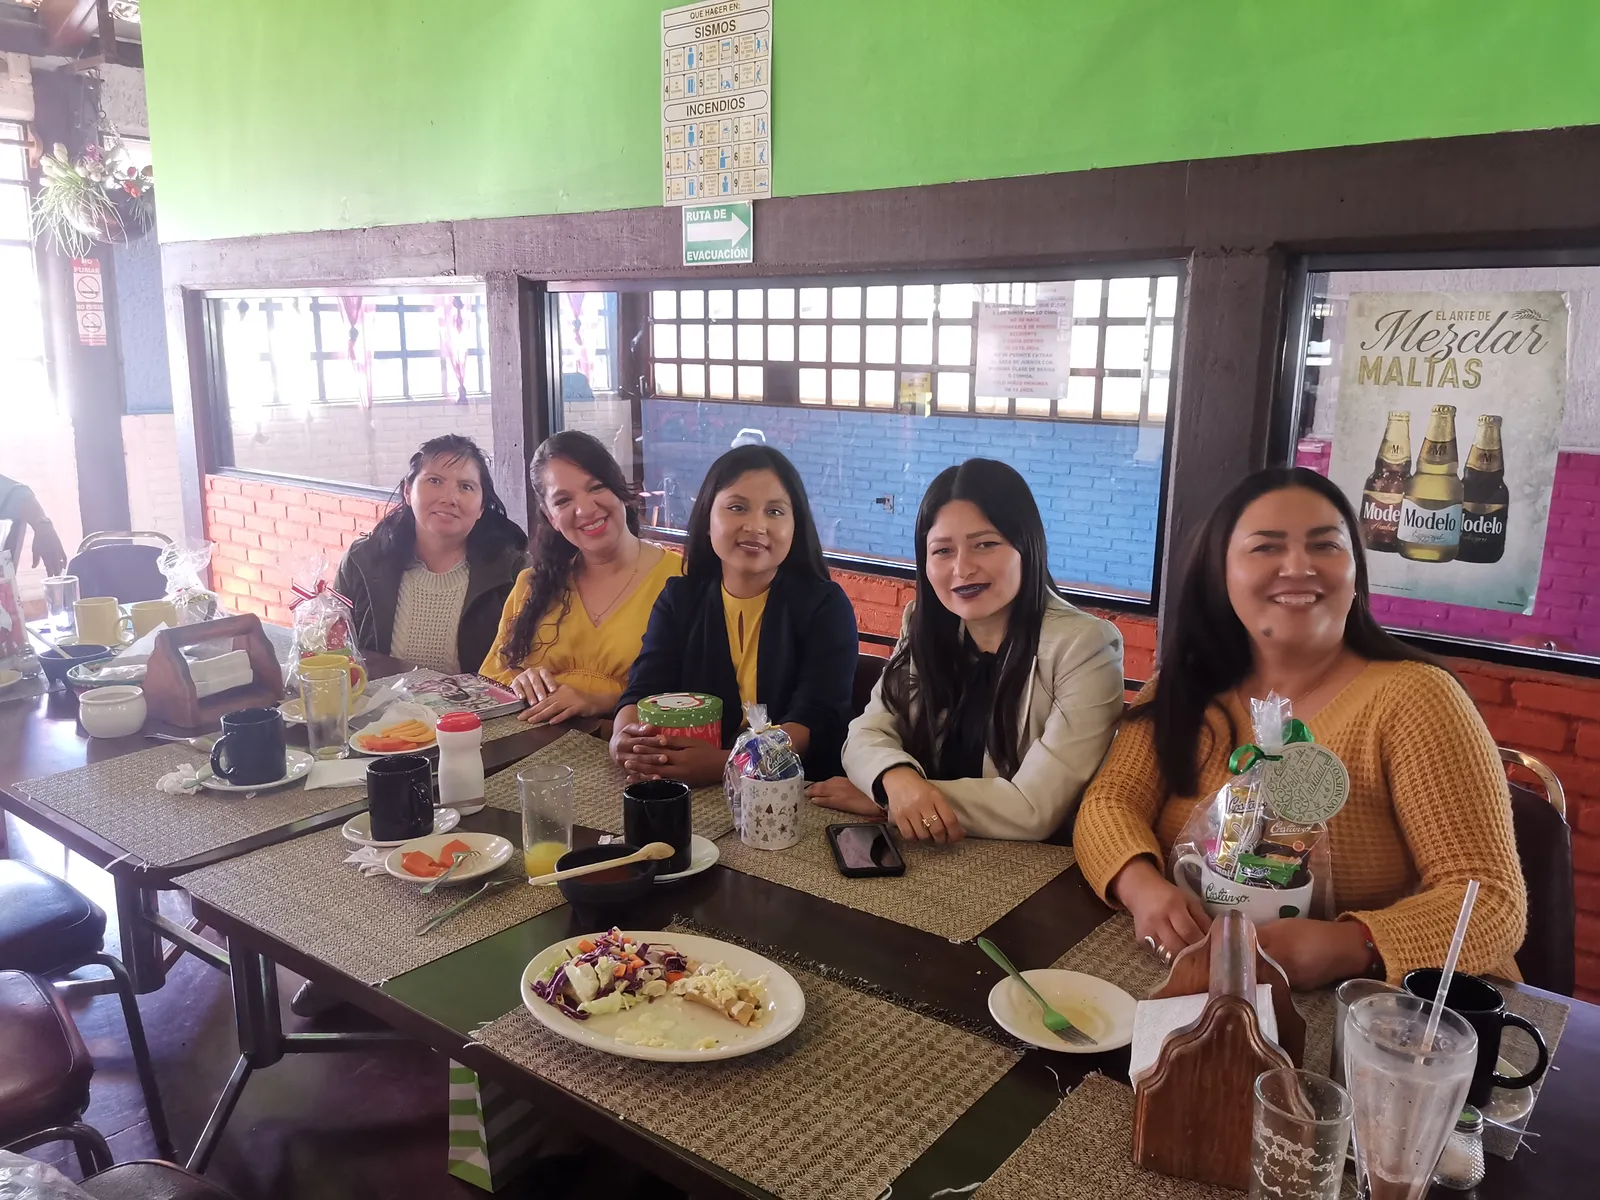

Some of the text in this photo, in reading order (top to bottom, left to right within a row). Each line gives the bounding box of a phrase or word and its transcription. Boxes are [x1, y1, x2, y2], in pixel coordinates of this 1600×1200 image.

[690, 11, 703, 20] QUE
[694, 20, 736, 38] SISMOS
[686, 97, 746, 116] INCENDIOS
[686, 209, 726, 222] RUTA DE
[686, 246, 748, 261] EVACUACIÓN
[1435, 310, 1492, 322] EL ARTE DE
[1360, 309, 1550, 363] Mezclar
[1358, 355, 1483, 390] MALTAS
[1404, 508, 1456, 532] Modelo
[1323, 798, 1339, 814] AÑO
[1332, 766, 1344, 799] NUEVO
